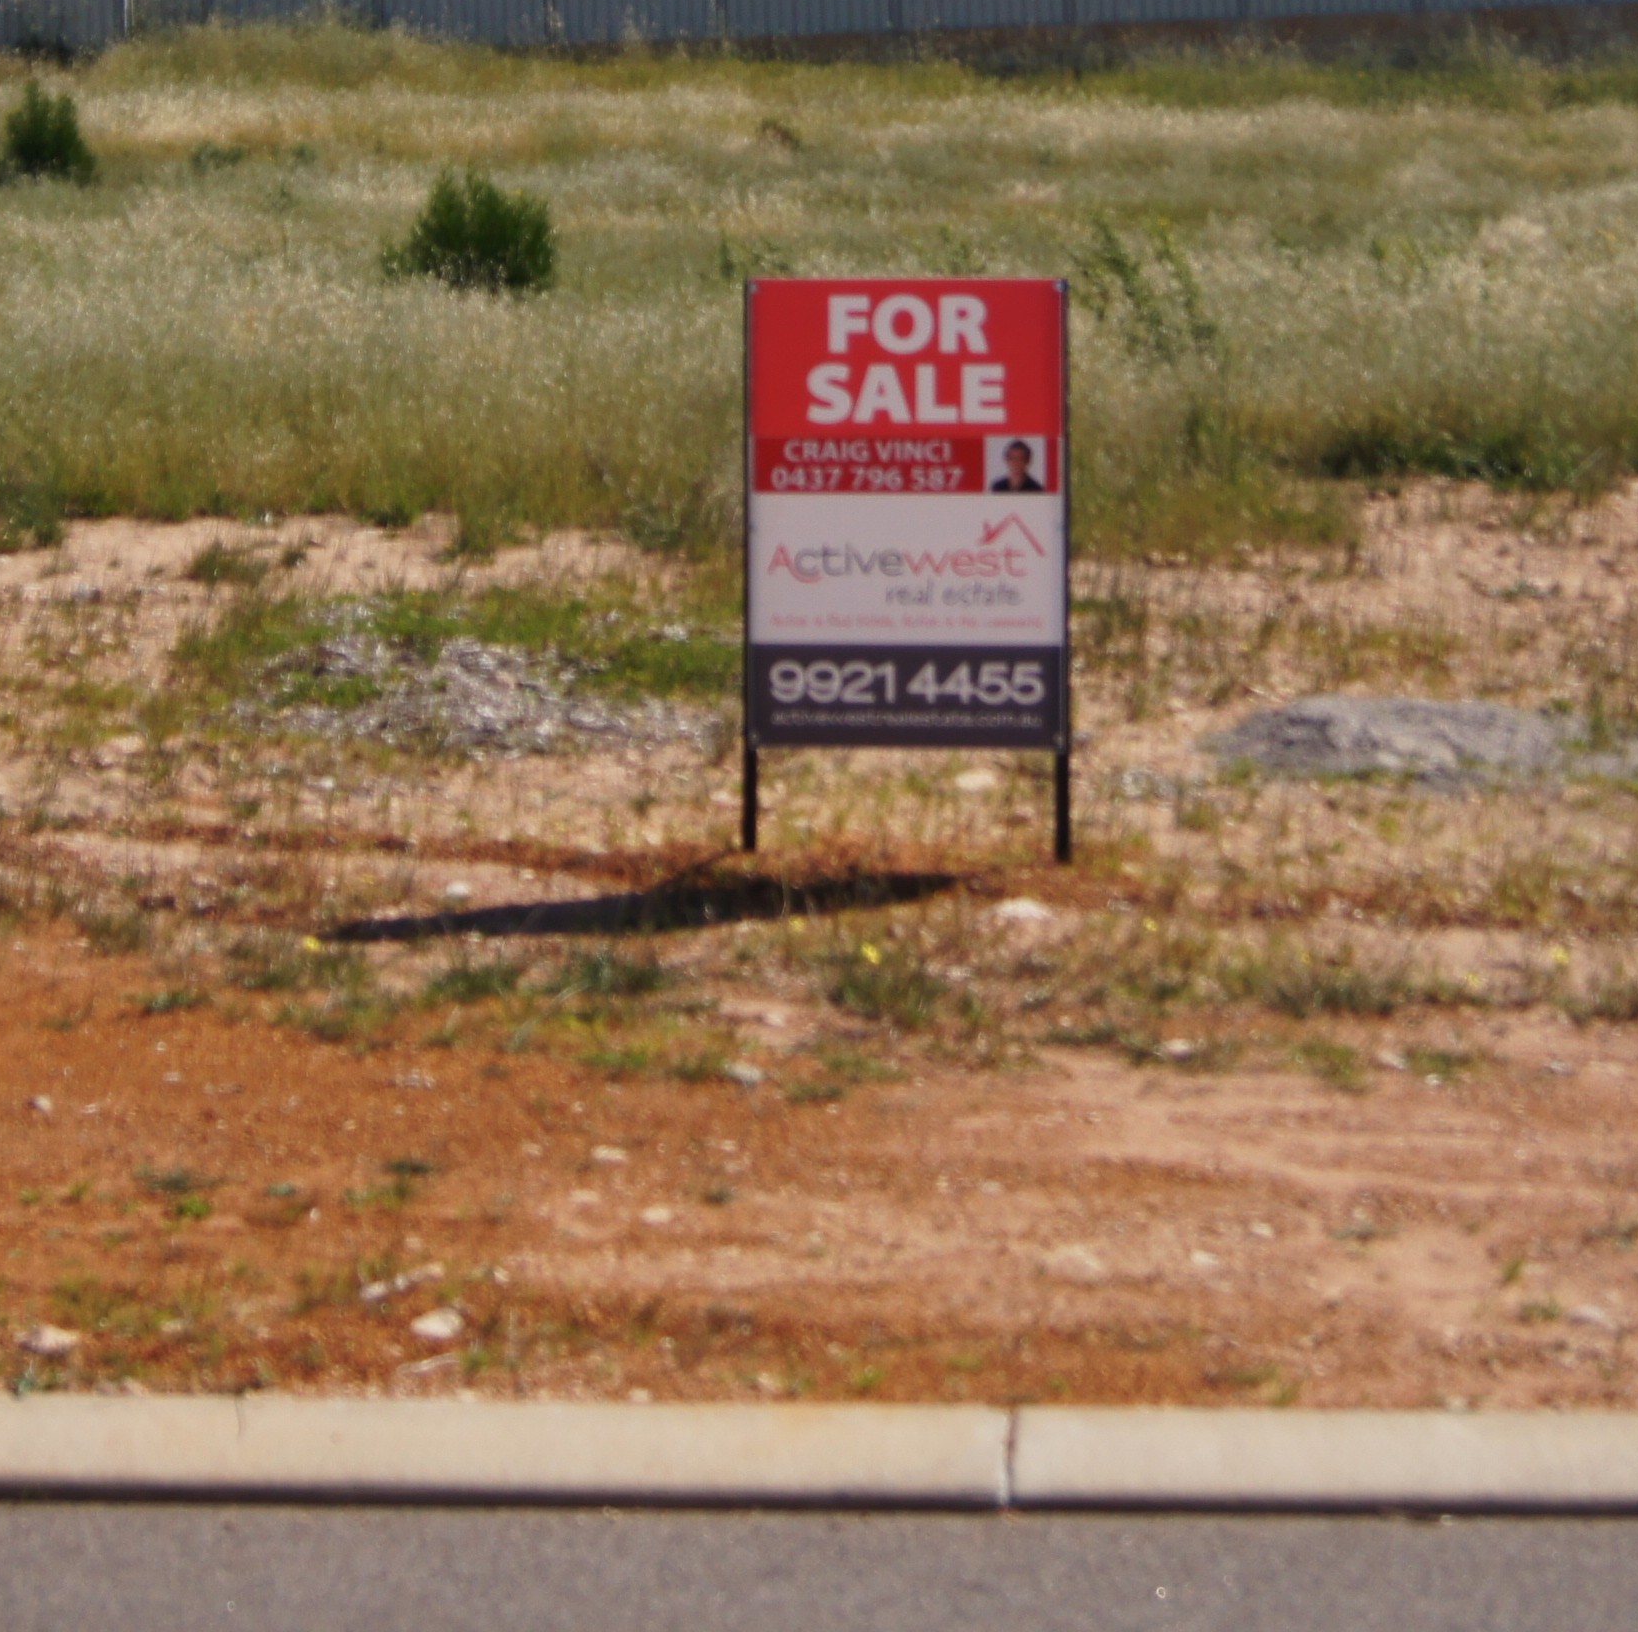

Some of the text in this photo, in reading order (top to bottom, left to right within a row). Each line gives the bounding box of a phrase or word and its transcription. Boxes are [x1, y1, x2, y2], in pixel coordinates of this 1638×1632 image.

[827, 294, 989, 354] FOR
[806, 362, 1008, 425] SALE
[783, 440, 952, 463] CRAIG VINCI
[771, 467, 963, 491] 0437 796 587
[767, 543, 1029, 583] Activewest
[885, 581, 1022, 607] real estate
[769, 659, 1045, 705] 9921 4455
